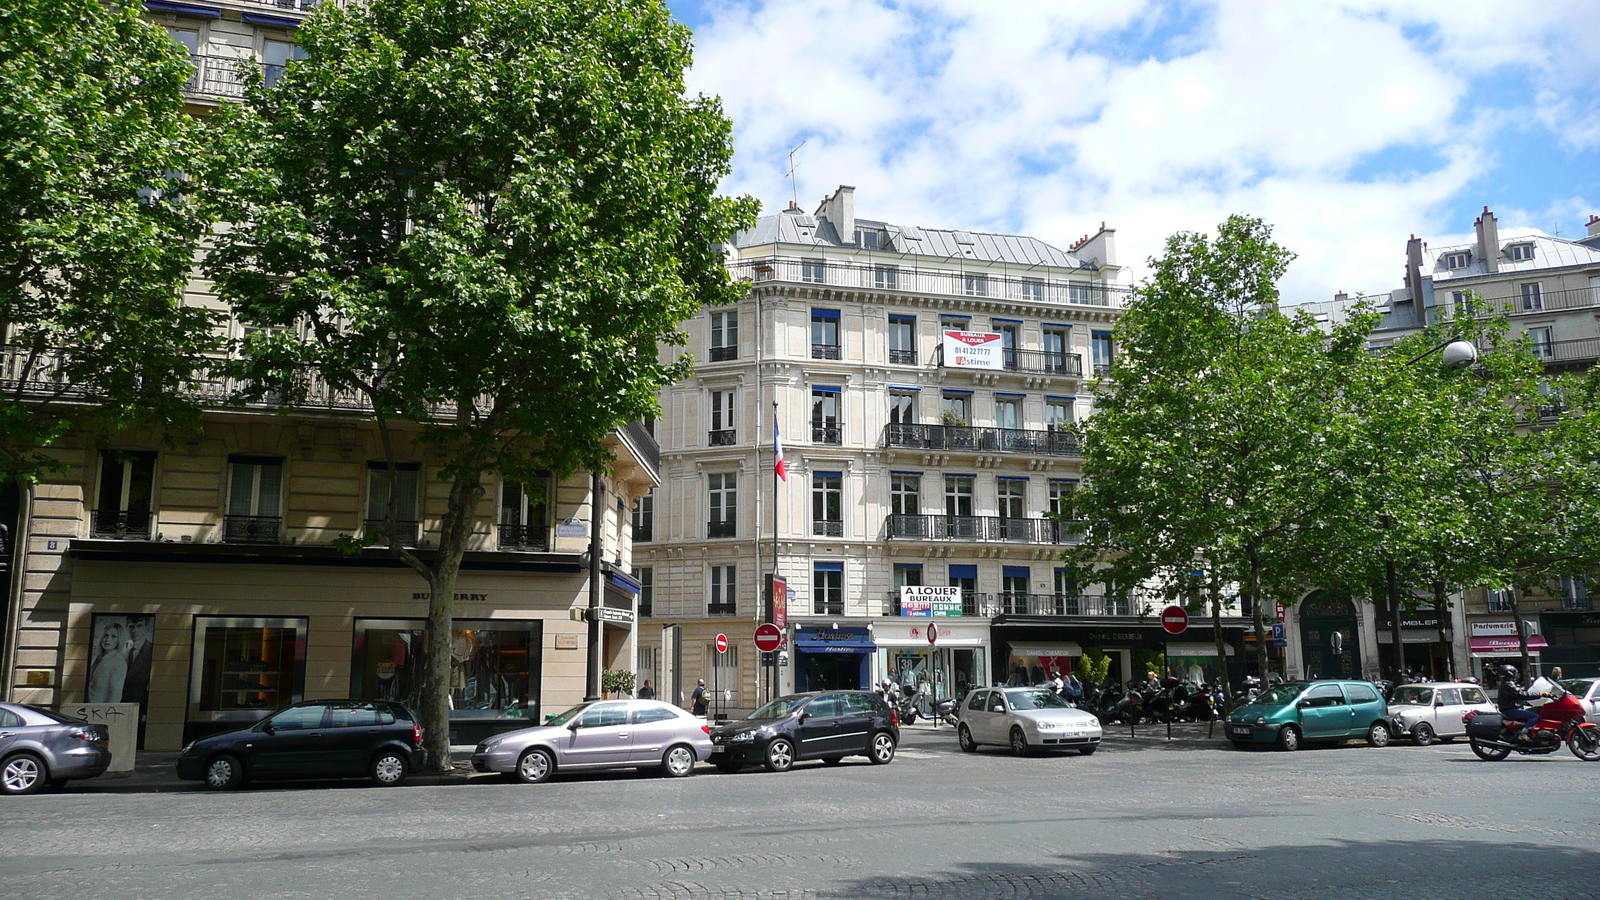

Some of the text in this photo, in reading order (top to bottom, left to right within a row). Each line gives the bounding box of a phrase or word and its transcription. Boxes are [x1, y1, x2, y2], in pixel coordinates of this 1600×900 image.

[905, 587, 957, 596] A LOUER
[412, 593, 488, 601] BUERRY
[910, 595, 952, 603] BUREAUX
[1275, 626, 1281, 637] P
[77, 707, 124, 724] SKA
